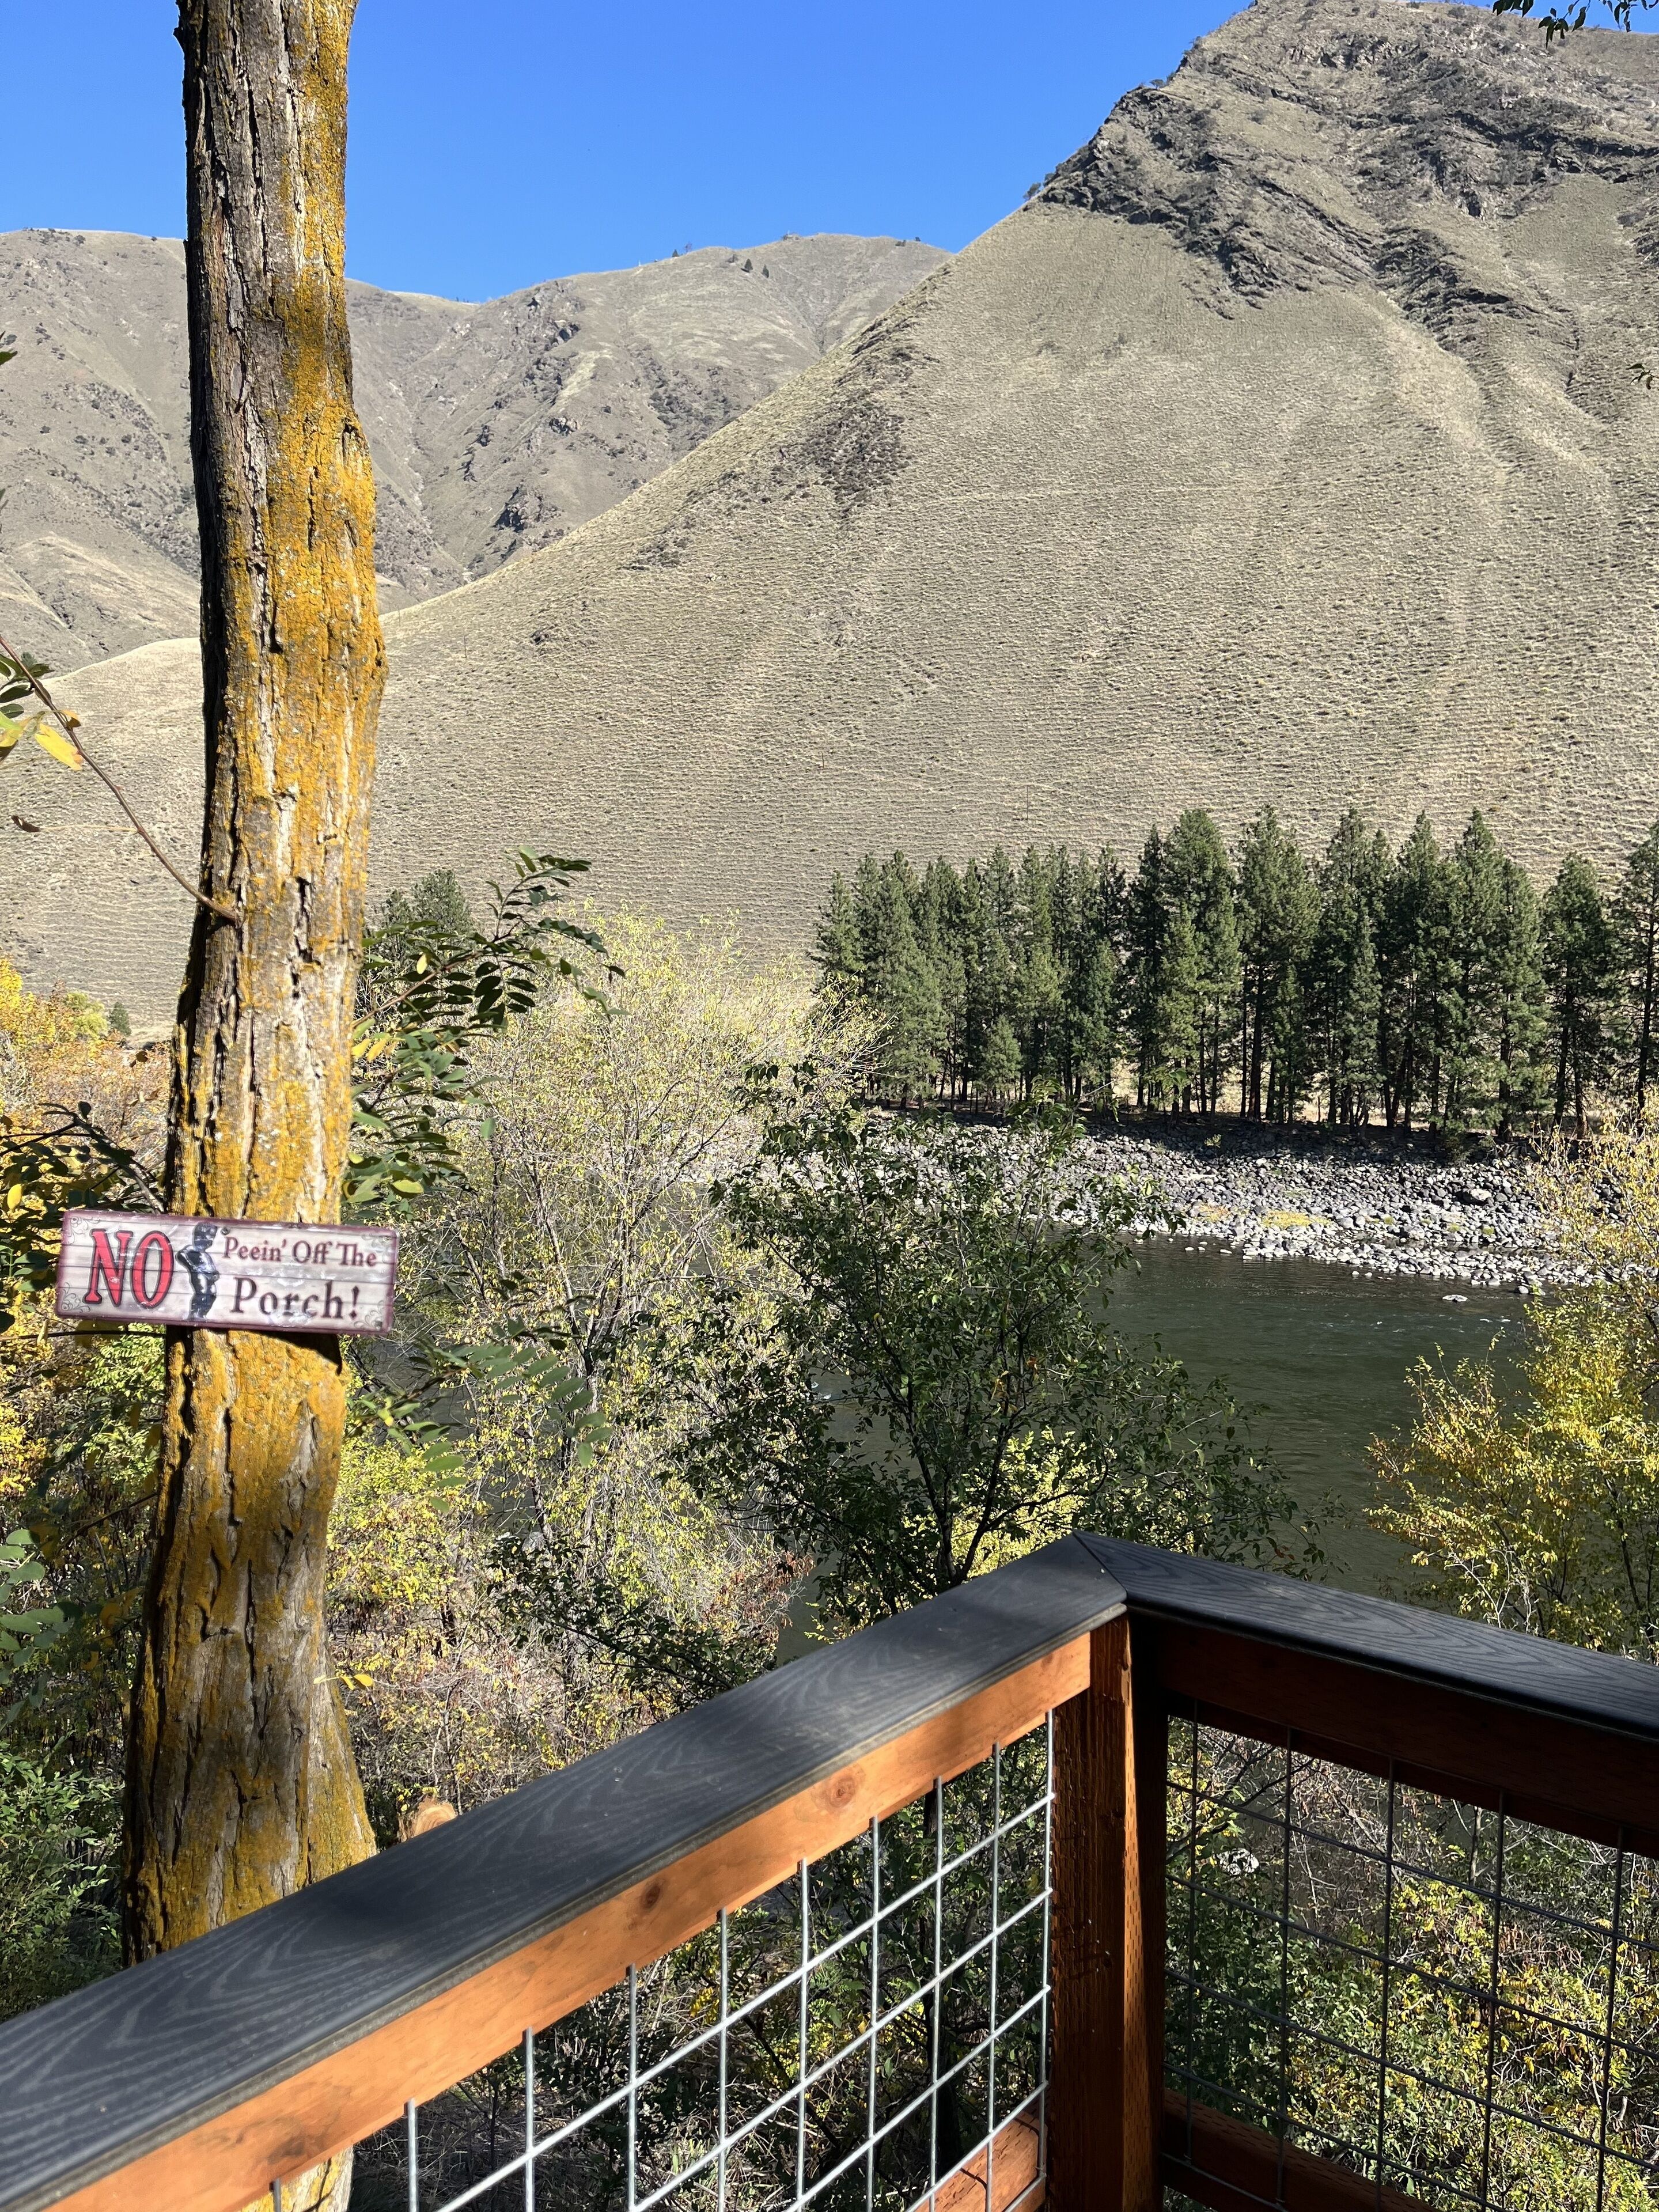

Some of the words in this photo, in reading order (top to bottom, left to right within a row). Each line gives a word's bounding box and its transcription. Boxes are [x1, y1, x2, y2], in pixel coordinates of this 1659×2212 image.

[84, 1228, 174, 1309] NO
[222, 1237, 286, 1262] Peein'
[292, 1240, 332, 1264] Off
[338, 1243, 377, 1267] The
[230, 1277, 360, 1319] Porch!
